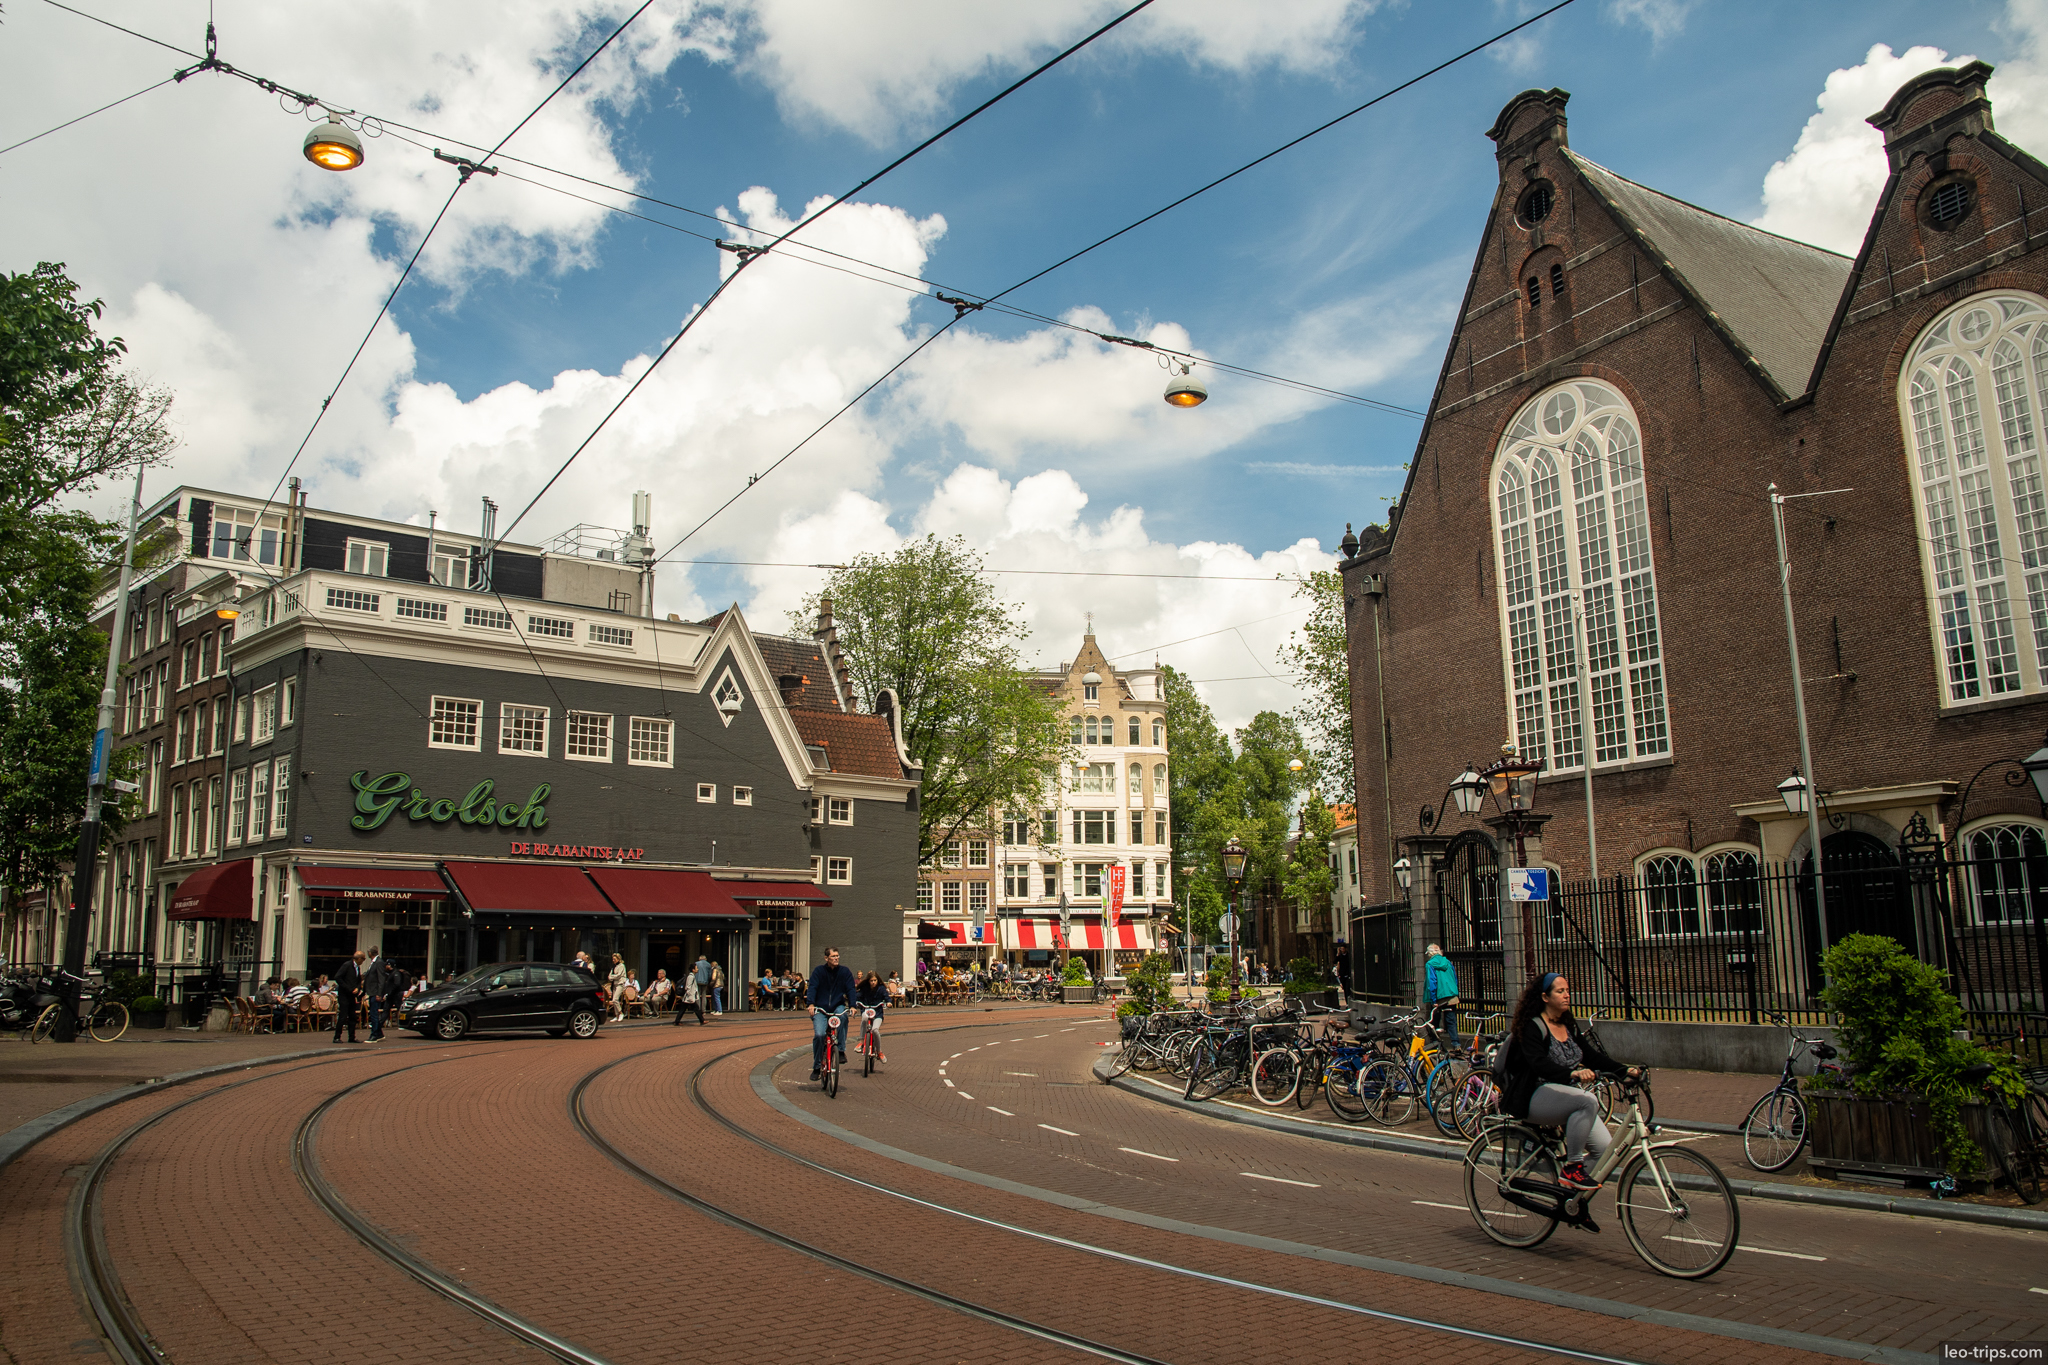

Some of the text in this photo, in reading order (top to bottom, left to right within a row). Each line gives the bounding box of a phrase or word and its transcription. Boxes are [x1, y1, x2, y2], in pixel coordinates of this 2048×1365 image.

[351, 770, 551, 831] Grolsch
[511, 842, 644, 860] DE BRABANTSE AAP
[344, 890, 354, 898] DE
[354, 891, 396, 899] BRABANTSE
